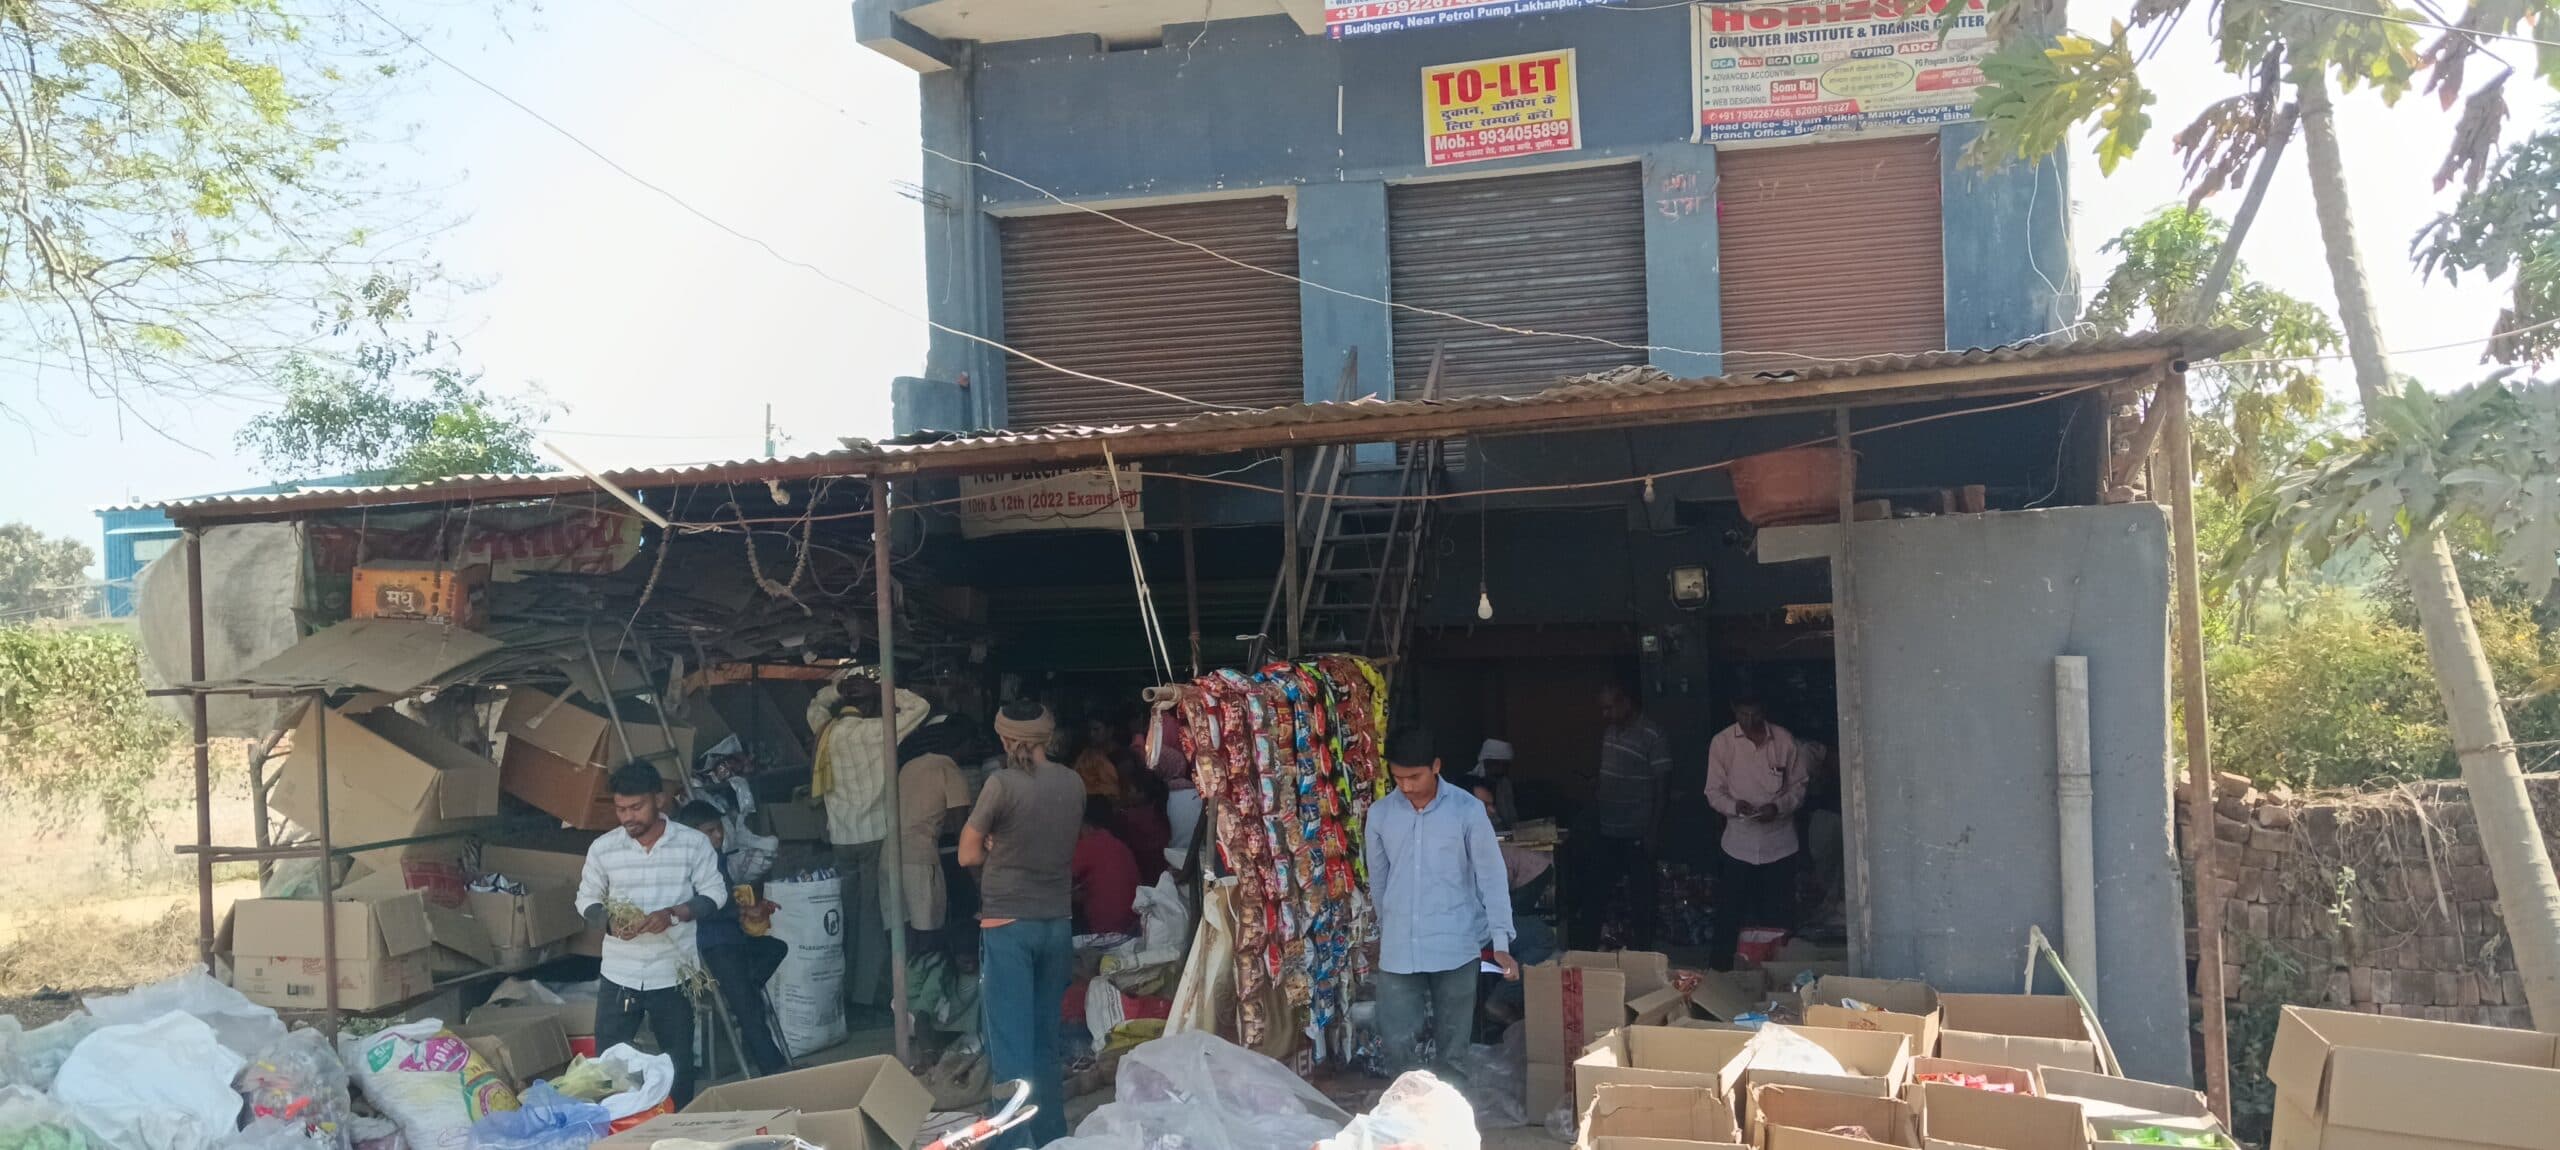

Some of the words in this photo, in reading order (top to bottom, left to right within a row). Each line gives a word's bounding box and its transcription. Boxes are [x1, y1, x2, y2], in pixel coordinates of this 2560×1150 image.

[1336, 6, 1368, 19] +91
[1344, 22, 1404, 35] Budhgere,
[1407, 16, 1435, 27] Near
[1439, 9, 1474, 22] Petrol
[1478, 7, 1511, 17] Pump
[1710, 33, 1780, 49] COMPUTER
[1785, 26, 1853, 44] INSTITUTE
[1857, 27, 1867, 38] &
[1870, 19, 1929, 36] TRANING
[1795, 54, 1816, 64] DTP
[1852, 46, 1892, 57] TYPING
[1432, 57, 1561, 106] TO-LET
[1713, 72, 1749, 81] ADVANCED
[1750, 69, 1795, 80] ACCOUNTING
[1713, 86, 1730, 94] DATA
[1800, 80, 1816, 93] Raj
[1543, 94, 1557, 105] के
[1713, 98, 1728, 106] WEB
[1730, 96, 1767, 105] DESIGNING
[1720, 111, 1734, 120] +91
[1446, 120, 1473, 131] लिए
[1711, 122, 1738, 131] Head
[1742, 120, 1779, 130] Office-
[1783, 117, 1821, 128] Shyam
[1711, 129, 1750, 140] Branch
[1754, 128, 1791, 138] Office-
[1907, 115, 1940, 125] Gaya,
[1435, 134, 1475, 151] Mob.:
[1479, 120, 1569, 146] 9934055899
[968, 497, 986, 512] 10th
[1002, 495, 1025, 512] 12th
[1028, 491, 1063, 512] (2022
